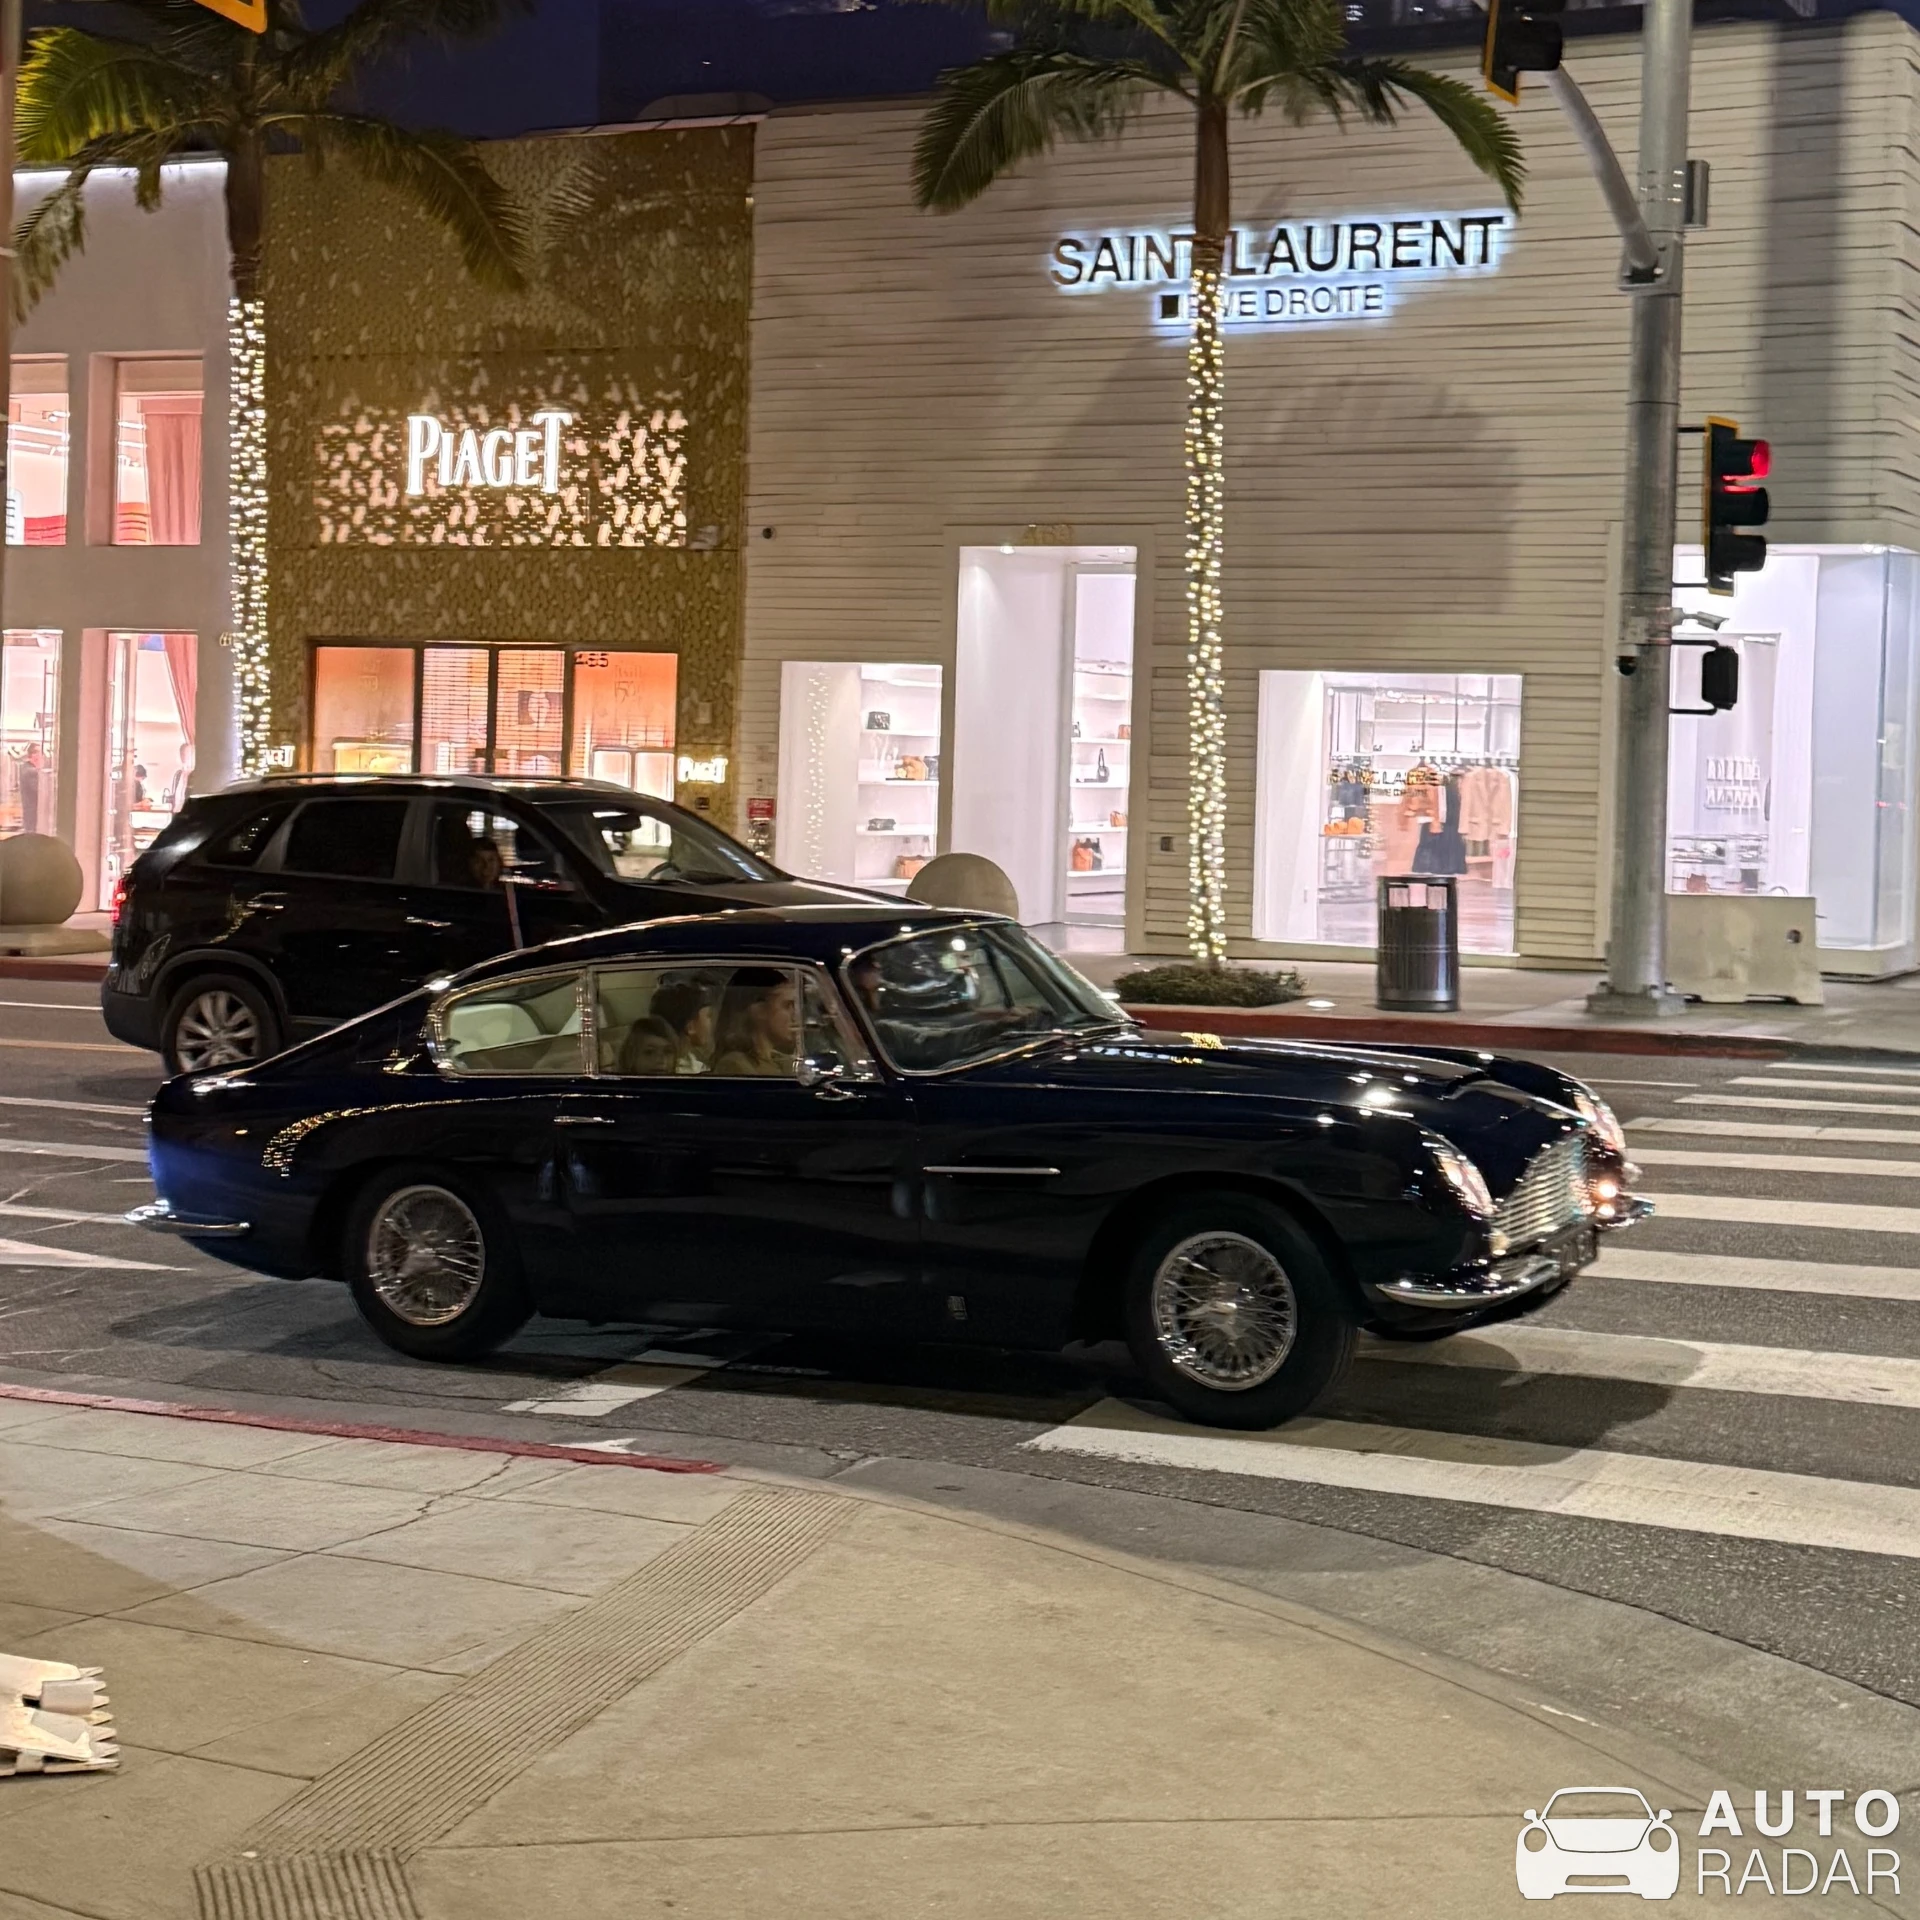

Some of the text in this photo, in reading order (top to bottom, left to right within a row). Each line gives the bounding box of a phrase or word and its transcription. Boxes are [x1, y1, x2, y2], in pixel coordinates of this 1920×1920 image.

[1051, 216, 1504, 285] SAIN LAURENT
[1265, 284, 1384, 316] DROITE
[406, 412, 573, 495] PIAGET
